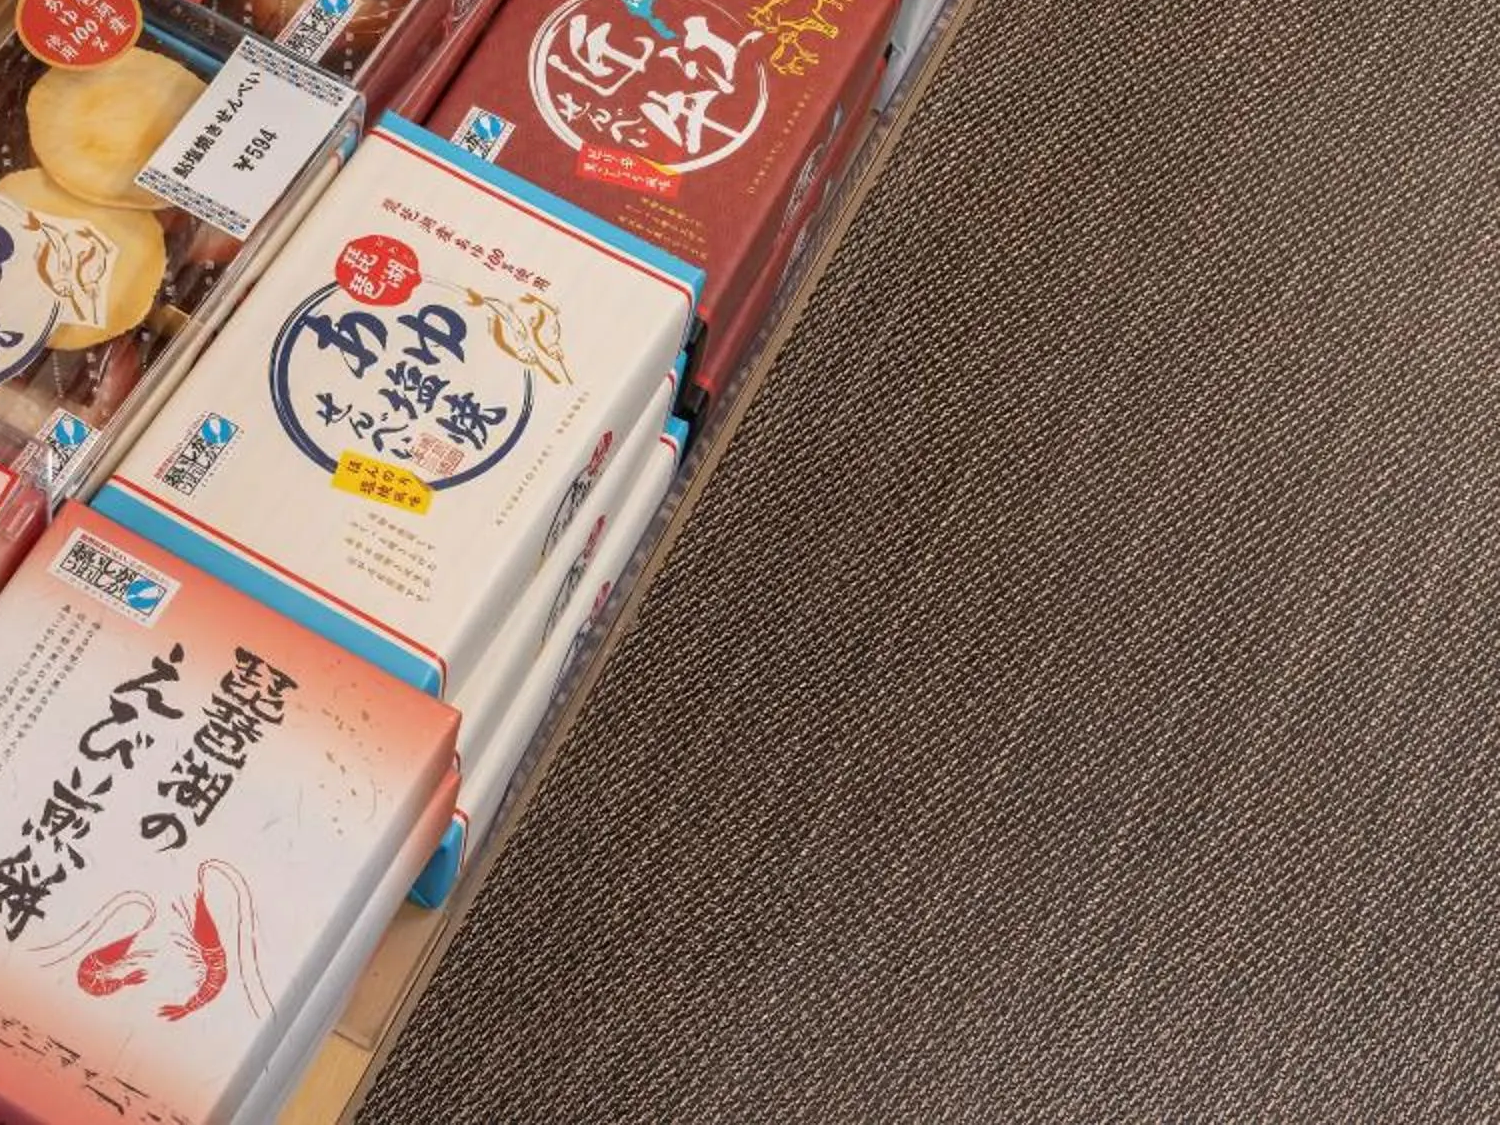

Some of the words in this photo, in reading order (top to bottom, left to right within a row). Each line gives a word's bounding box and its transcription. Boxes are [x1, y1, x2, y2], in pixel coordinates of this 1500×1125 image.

[174, 69, 262, 179] 鮎塩焼きせんべい
[232, 128, 279, 175] ¥594
[343, 245, 408, 301] 琵琶湖
[302, 303, 468, 379] あゆ
[316, 393, 412, 461] せんべい
[378, 361, 507, 451] 塩焼
[140, 646, 298, 851] 琵琶湖の
